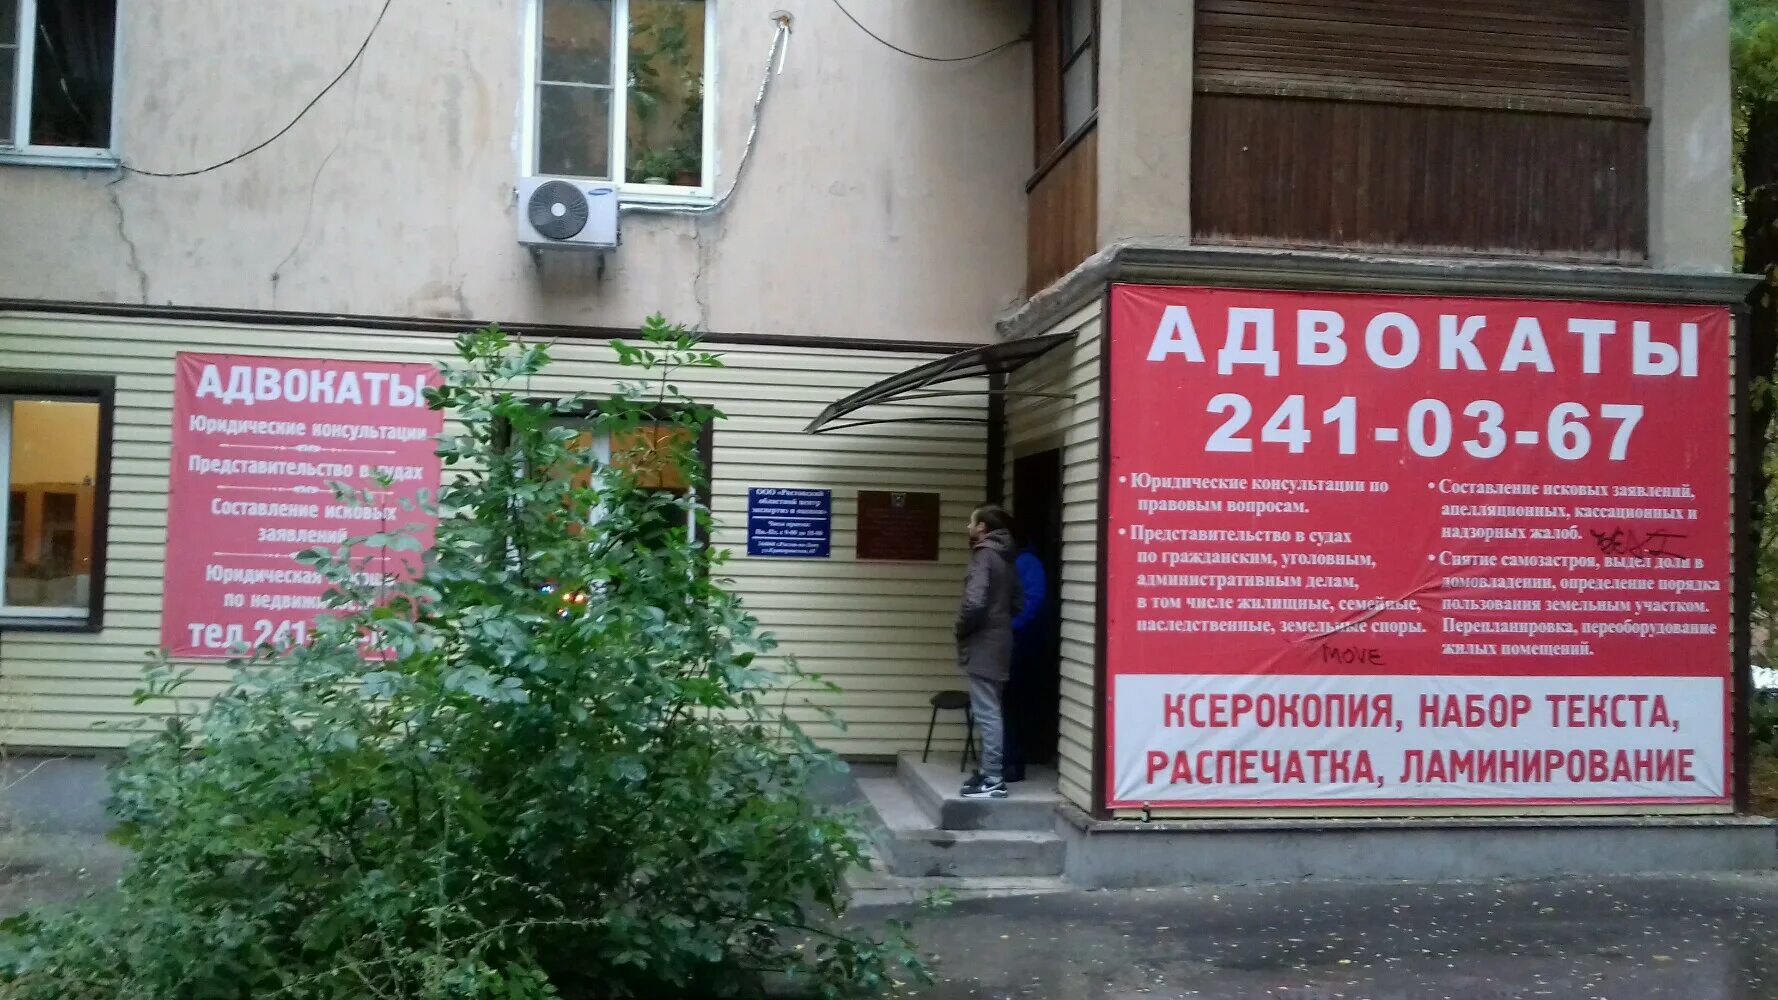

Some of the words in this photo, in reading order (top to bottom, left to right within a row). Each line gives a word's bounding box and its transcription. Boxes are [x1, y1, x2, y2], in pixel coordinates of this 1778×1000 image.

[1146, 305, 1698, 377] АДВОКАТЫ
[196, 364, 427, 408] АДВОКАТЫ
[189, 415, 306, 436] Юридические
[312, 422, 427, 442] консультации
[1205, 393, 1644, 461] 241-03-67
[188, 455, 353, 477] Представительство
[359, 464, 369, 478] в
[1131, 472, 1247, 491] Юридические
[1251, 476, 1365, 494] консультации
[1369, 480, 1389, 493] по
[1438, 479, 1539, 496] Составление
[1543, 484, 1609, 497] исковых
[1612, 484, 1696, 500] заявлений,
[211, 498, 318, 518] Составление
[324, 506, 397, 521] исковых
[1138, 499, 1222, 515] правовым
[1227, 501, 1310, 517] вопросам.
[1441, 503, 1571, 519] апелляционных,
[1574, 506, 1684, 520] кассационных
[1687, 509, 1697, 520] и
[257, 527, 347, 544] заявлений
[1131, 525, 1291, 544] Представительство
[1295, 531, 1306, 542] в
[1309, 532, 1352, 546] судах
[1441, 526, 1526, 541] надзорных
[1529, 525, 1583, 540] жалоб.
[1137, 551, 1158, 564] по
[1161, 551, 1277, 568] гражданским,
[1281, 554, 1377, 569] уголовным,
[1438, 550, 1497, 567] Снятие
[1501, 554, 1600, 571] самозастроя,
[1604, 555, 1651, 569] выдел
[1654, 556, 1691, 570] доли
[1695, 558, 1704, 569] в
[206, 564, 322, 585] Юридическая
[1137, 574, 1301, 590] административным
[1305, 575, 1359, 591] делам,
[1441, 576, 1557, 590] домовладении,
[1560, 577, 1654, 592] определение
[1658, 579, 1721, 593] порядка
[224, 593, 245, 608] по
[1136, 598, 1148, 609] в
[1151, 597, 1181, 609] том
[1186, 597, 1233, 610] числе
[1237, 597, 1336, 613] жилищные,
[1338, 595, 1422, 614] семейные,
[1441, 598, 1541, 612] пользования
[1545, 599, 1631, 613] земельным
[1635, 600, 1710, 616] участком.
[1136, 619, 1276, 636] наследственные,
[1280, 619, 1367, 634] земельные
[1371, 620, 1427, 637] споры.
[1442, 618, 1578, 637] Перепланировка,
[1581, 621, 1717, 637] переоборудование
[1322, 644, 1385, 666] MOVE
[1441, 641, 1497, 655] жилых
[1501, 641, 1594, 656] помещений.
[1163, 693, 1404, 732] КСЕРОКОПИЯ,
[1419, 693, 1532, 728] НАБОР
[1545, 694, 1680, 733] ТЕКСТА,
[1146, 750, 1385, 789] РАСПЕЧАТКА,
[1399, 748, 1696, 784] ЛАМИНИРОВАНИЕ
